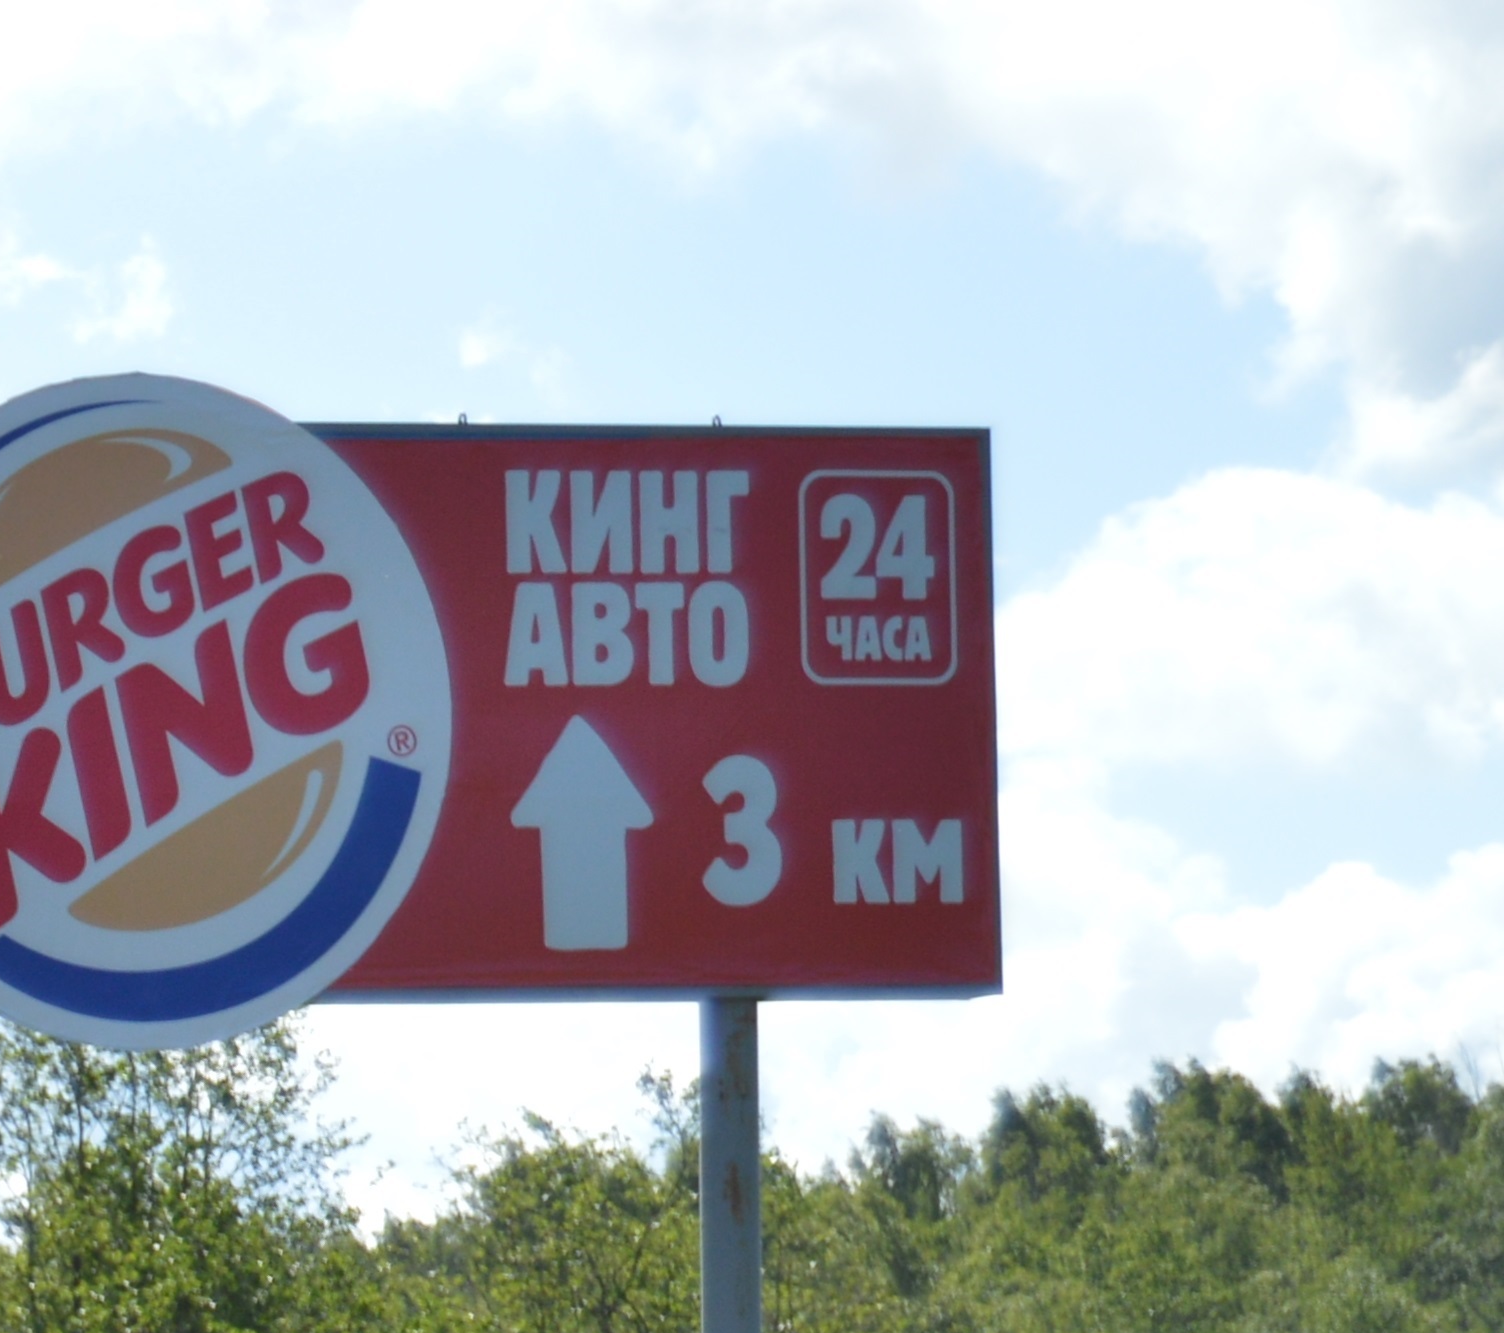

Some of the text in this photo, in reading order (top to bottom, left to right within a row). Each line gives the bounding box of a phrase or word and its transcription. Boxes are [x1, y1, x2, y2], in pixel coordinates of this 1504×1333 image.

[504, 470, 749, 574] КИНГ
[820, 494, 935, 600] 24
[504, 581, 749, 687] АВТО
[826, 615, 932, 662] ЧАСА
[702, 754, 782, 907] 3
